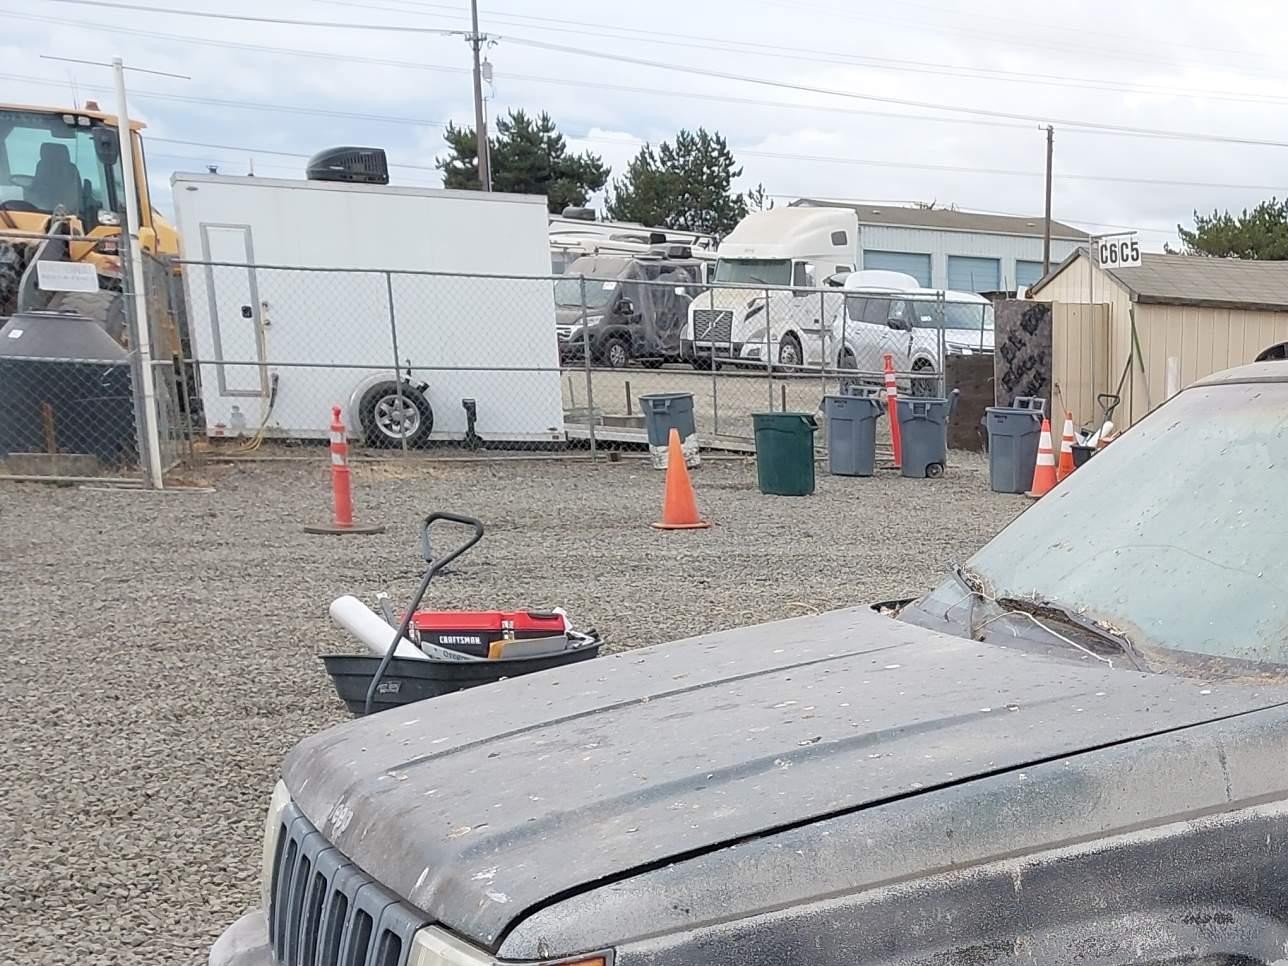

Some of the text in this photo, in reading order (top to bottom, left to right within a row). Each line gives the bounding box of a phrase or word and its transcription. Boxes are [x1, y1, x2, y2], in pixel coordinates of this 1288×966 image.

[1100, 241, 1140, 264] C6 C5
[439, 636, 481, 645] CRAFTSMAN
